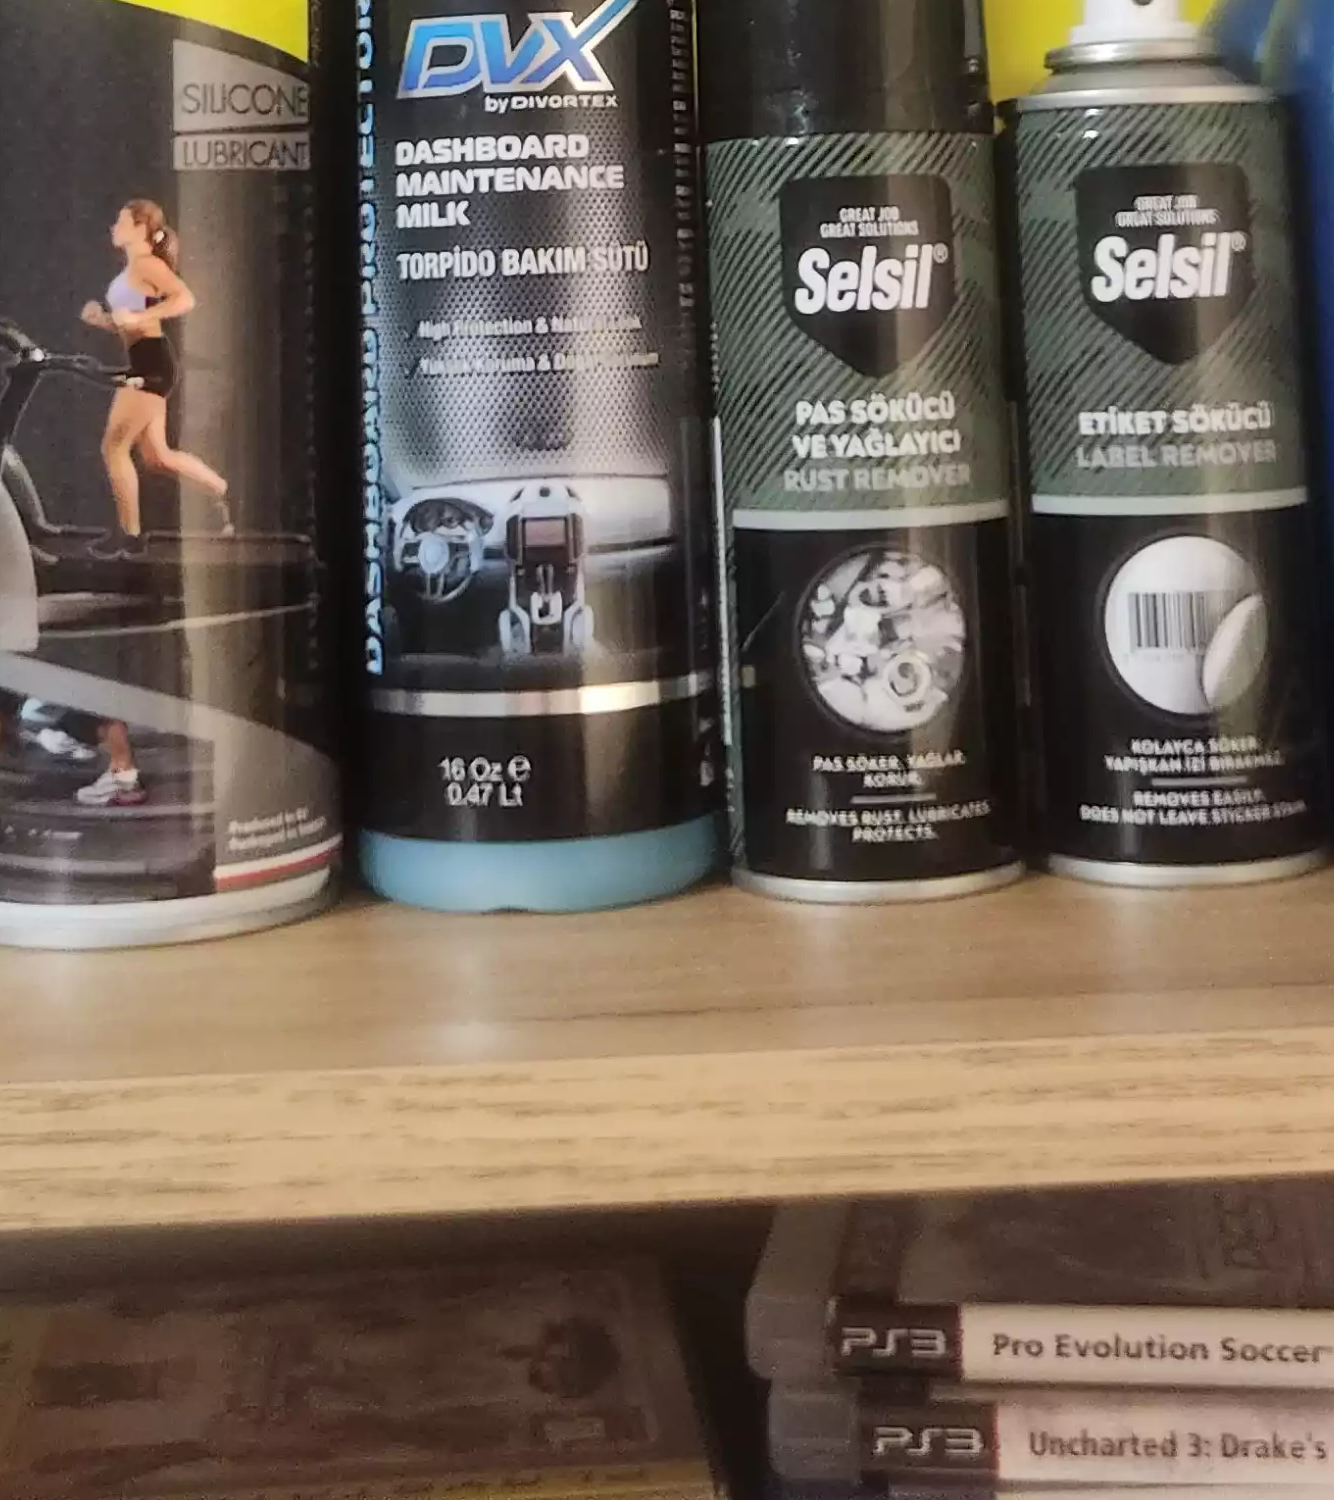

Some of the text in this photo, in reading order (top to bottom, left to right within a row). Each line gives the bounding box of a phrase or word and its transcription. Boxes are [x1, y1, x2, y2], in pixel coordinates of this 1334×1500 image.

[181, 83, 308, 118] SILICONE
[484, 93, 619, 114] by DIVORTEX
[182, 139, 309, 168] LUBRICANT
[395, 134, 590, 166] DASHBOARD
[395, 165, 624, 197] MAINTENANCE
[396, 200, 470, 229] MILK
[819, 220, 920, 238] GREAT SOLUTIONS
[839, 206, 901, 223] GREAT JOB
[397, 245, 496, 280] TORPİDO
[501, 246, 586, 277] BAKIM
[796, 390, 956, 425] PAS SÖKÜCÜ
[1078, 400, 1272, 436] ETİKET SÖKÜCÜ
[792, 427, 961, 458] VE YAĞLAYICI
[1077, 439, 1277, 468] LABEL REMOVER
[783, 463, 971, 492] RUST REMOVER
[360, 327, 385, 675] DASHBOARD
[468, 756, 504, 781] Oz
[1121, 807, 1156, 825] NOT
[840, 1326, 947, 1359] PS3
[992, 1332, 1045, 1358] Pro
[1055, 1332, 1209, 1362] Evolution
[871, 1425, 986, 1459] PS3
[1029, 1428, 1178, 1458] Uncharted
[1187, 1431, 1212, 1460] 3:
[1220, 1430, 1327, 1461] Drake's
